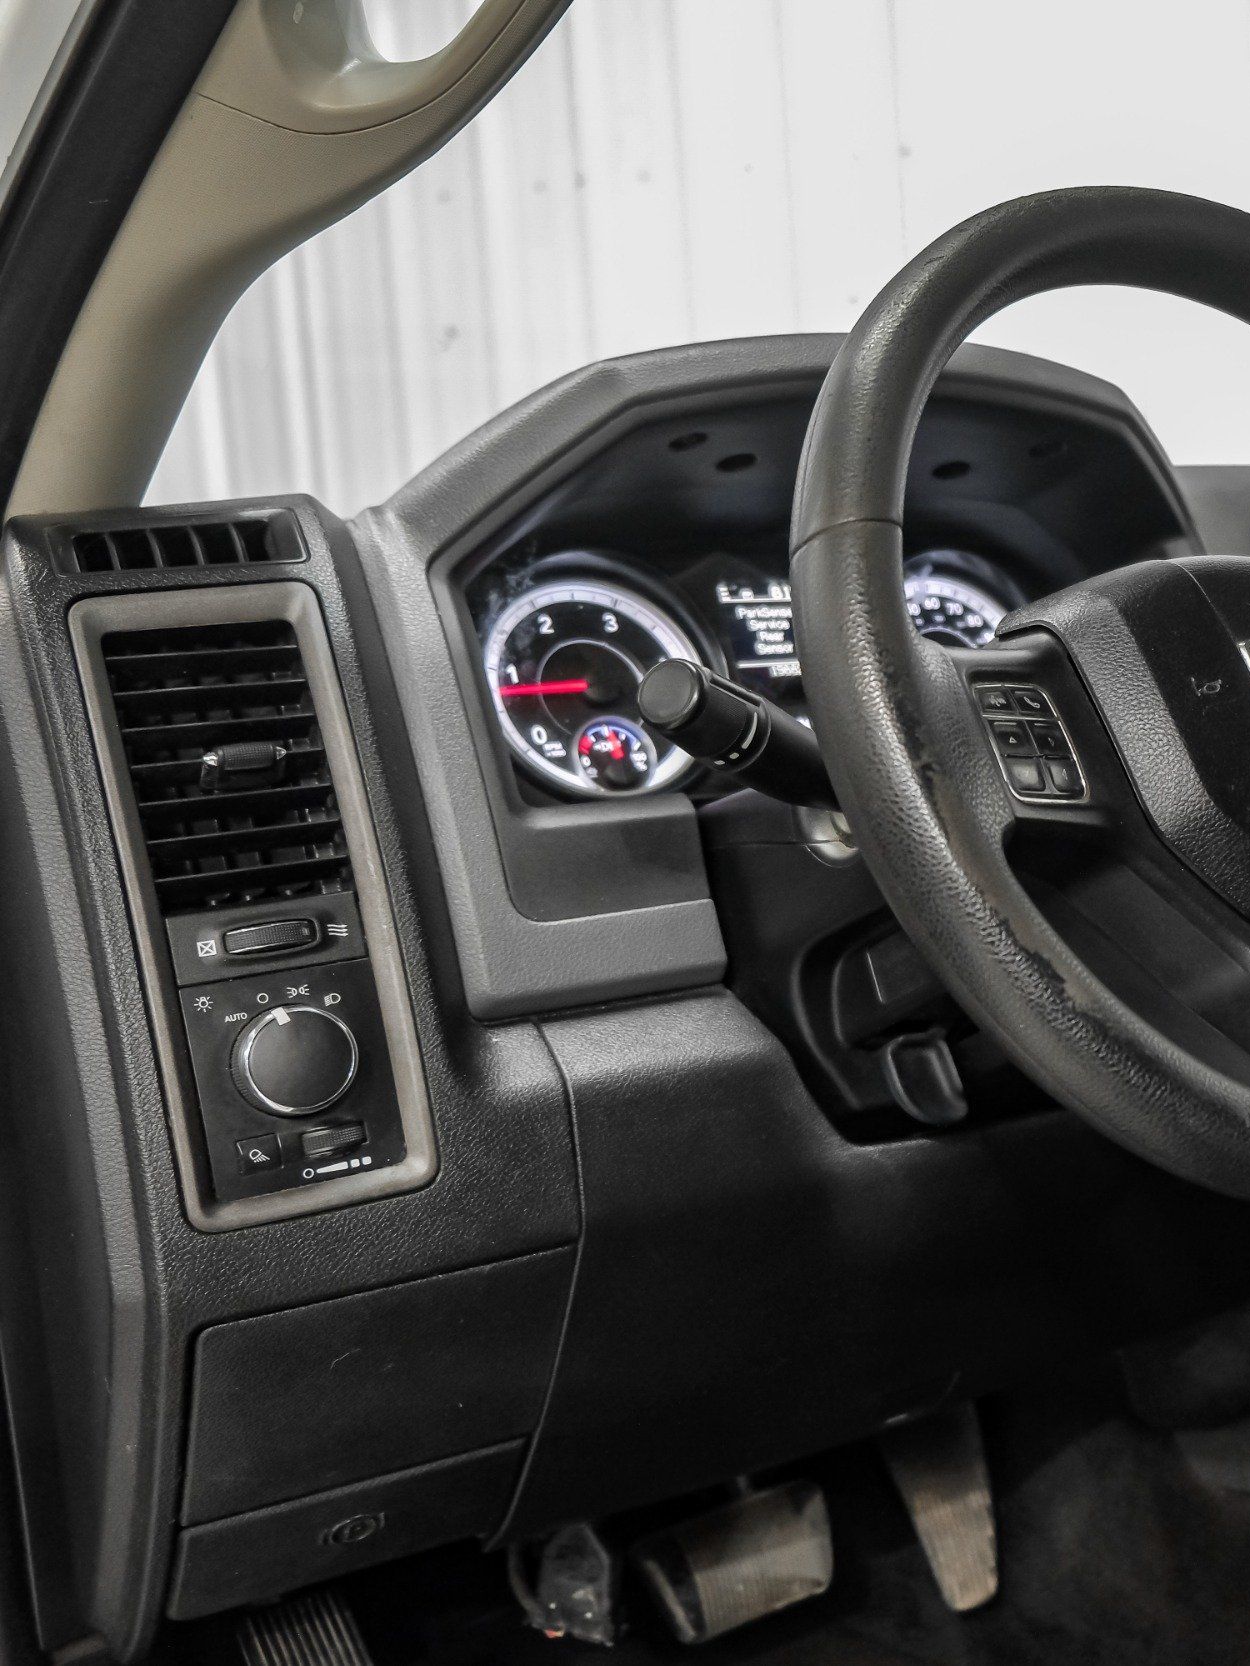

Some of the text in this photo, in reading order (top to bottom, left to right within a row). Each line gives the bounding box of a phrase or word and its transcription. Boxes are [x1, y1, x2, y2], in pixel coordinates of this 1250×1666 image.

[924, 597, 940, 610] 60
[946, 603, 963, 616] 70
[537, 613, 554, 635] 2
[602, 613, 619, 633] 3
[967, 614, 983, 627] 80
[506, 663, 519, 684] 1
[530, 725, 547, 745] 0
[224, 1012, 247, 1023] AUTO
